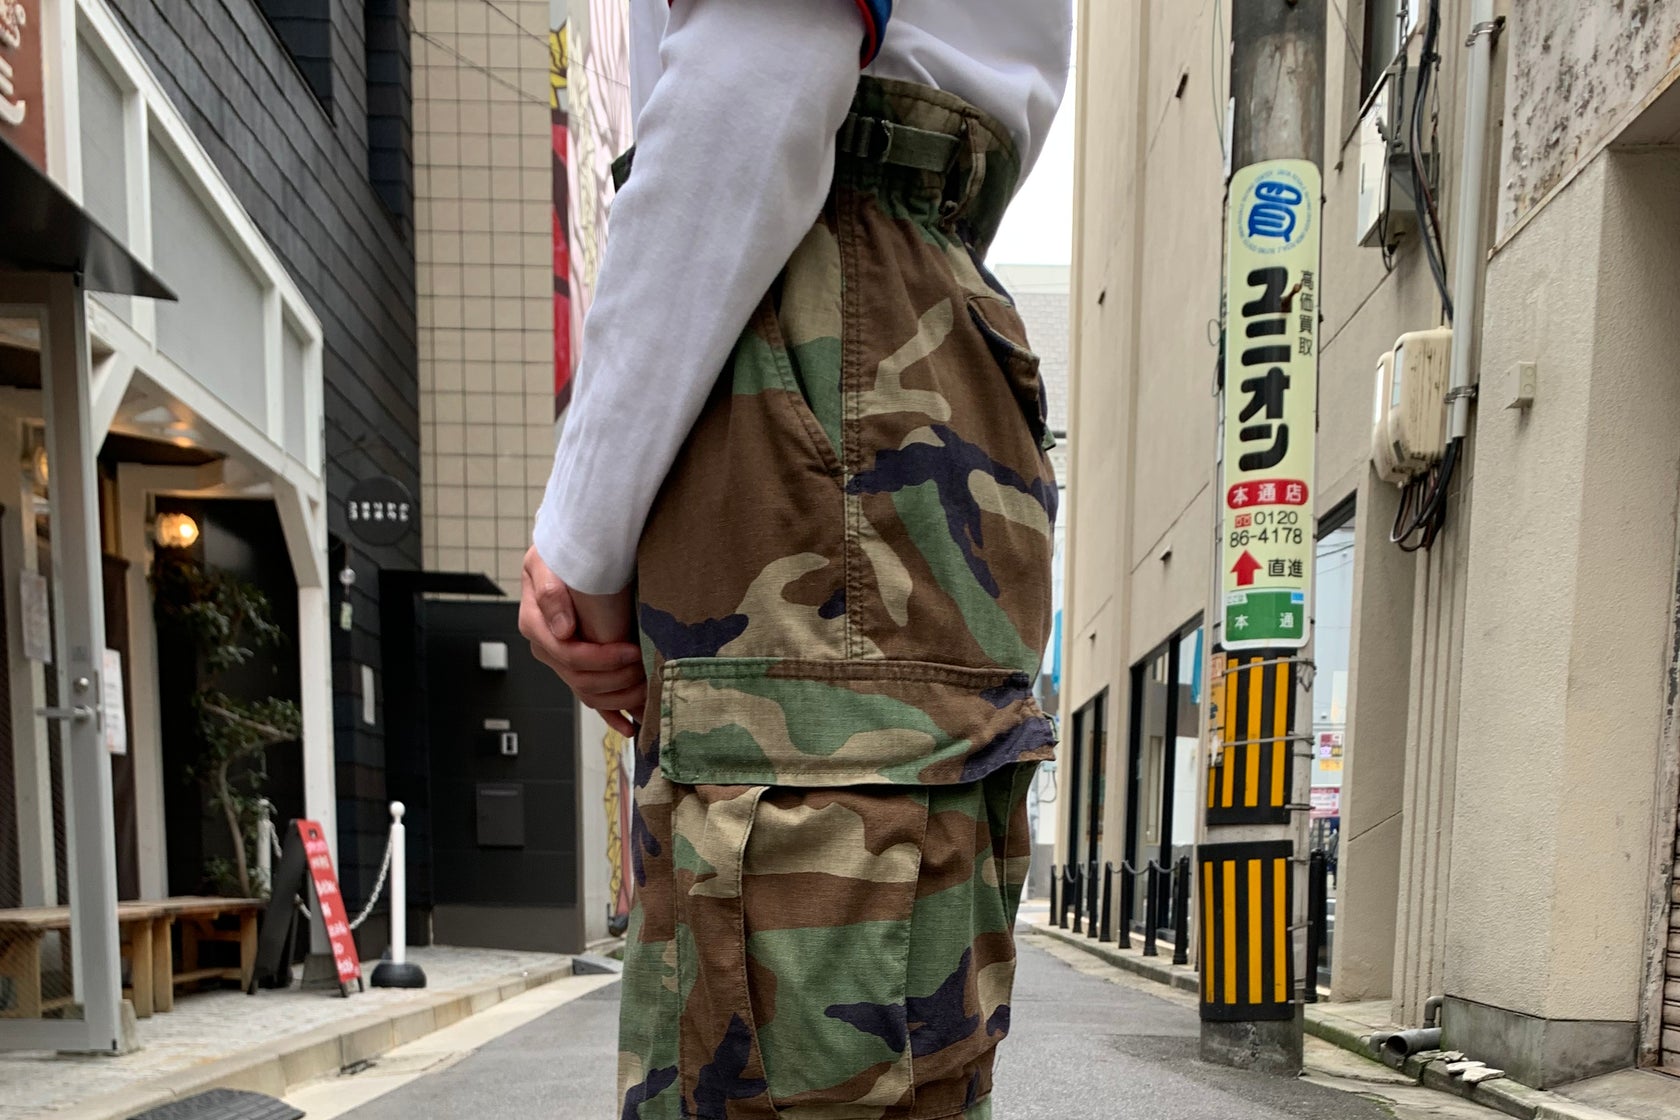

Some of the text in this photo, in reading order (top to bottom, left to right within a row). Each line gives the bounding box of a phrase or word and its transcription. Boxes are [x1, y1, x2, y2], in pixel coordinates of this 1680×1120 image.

[1298, 270, 1314, 357] 高価買取
[1238, 266, 1292, 472] ユニオン
[1232, 483, 1302, 505] 本通店
[1254, 510, 1298, 525] 0120
[1230, 527, 1303, 548] 86-4178
[1268, 558, 1303, 578] 直進
